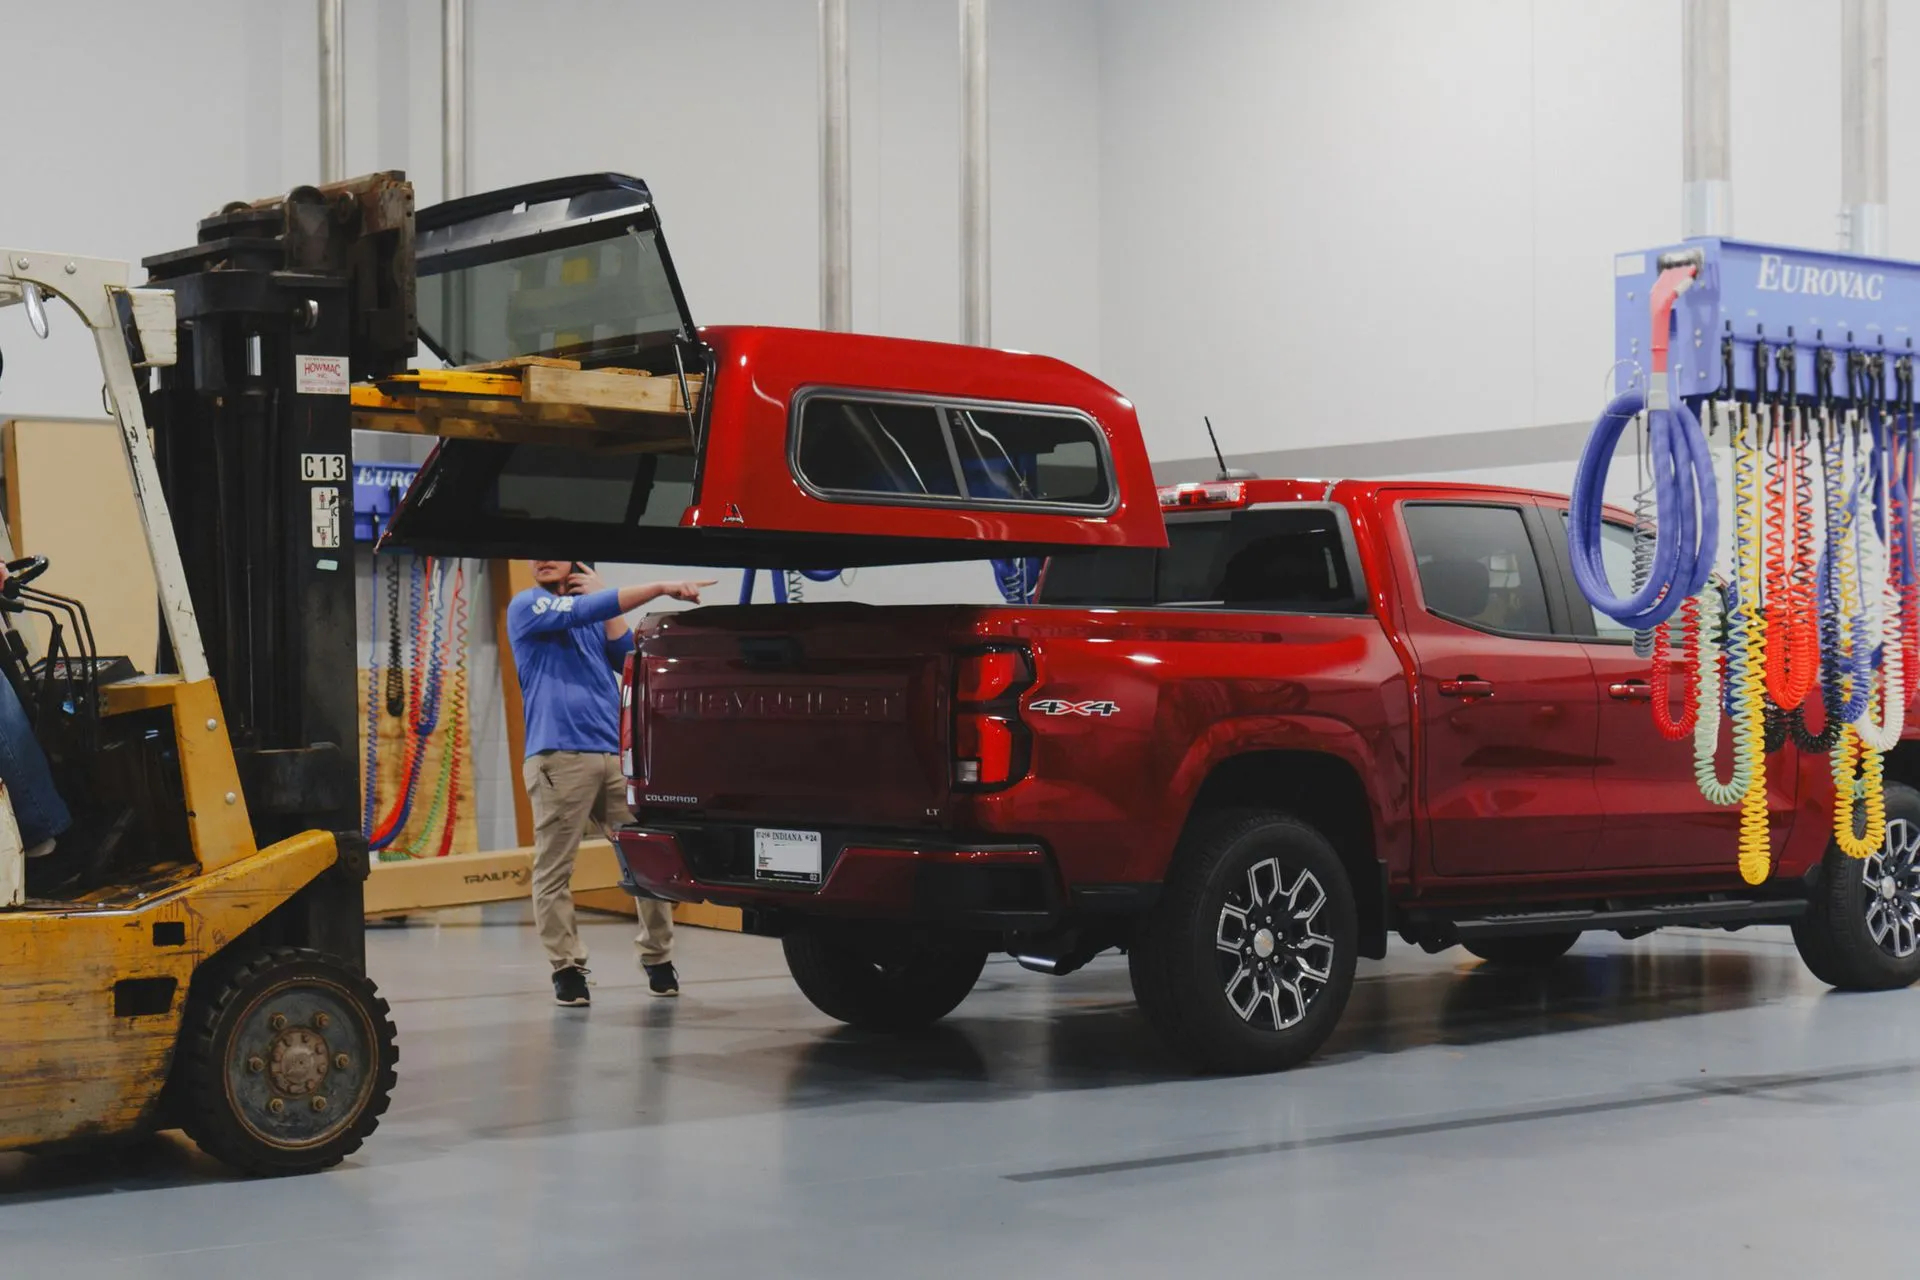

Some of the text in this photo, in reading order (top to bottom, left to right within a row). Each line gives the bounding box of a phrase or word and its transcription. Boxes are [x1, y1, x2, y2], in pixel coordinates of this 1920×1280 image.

[1756, 254, 1885, 301] EUROVAC
[303, 361, 341, 377] HOWMAC
[304, 455, 344, 479] C13
[645, 794, 698, 804] COLORADO
[926, 808, 940, 816] LT
[772, 831, 803, 841] INDIANA
